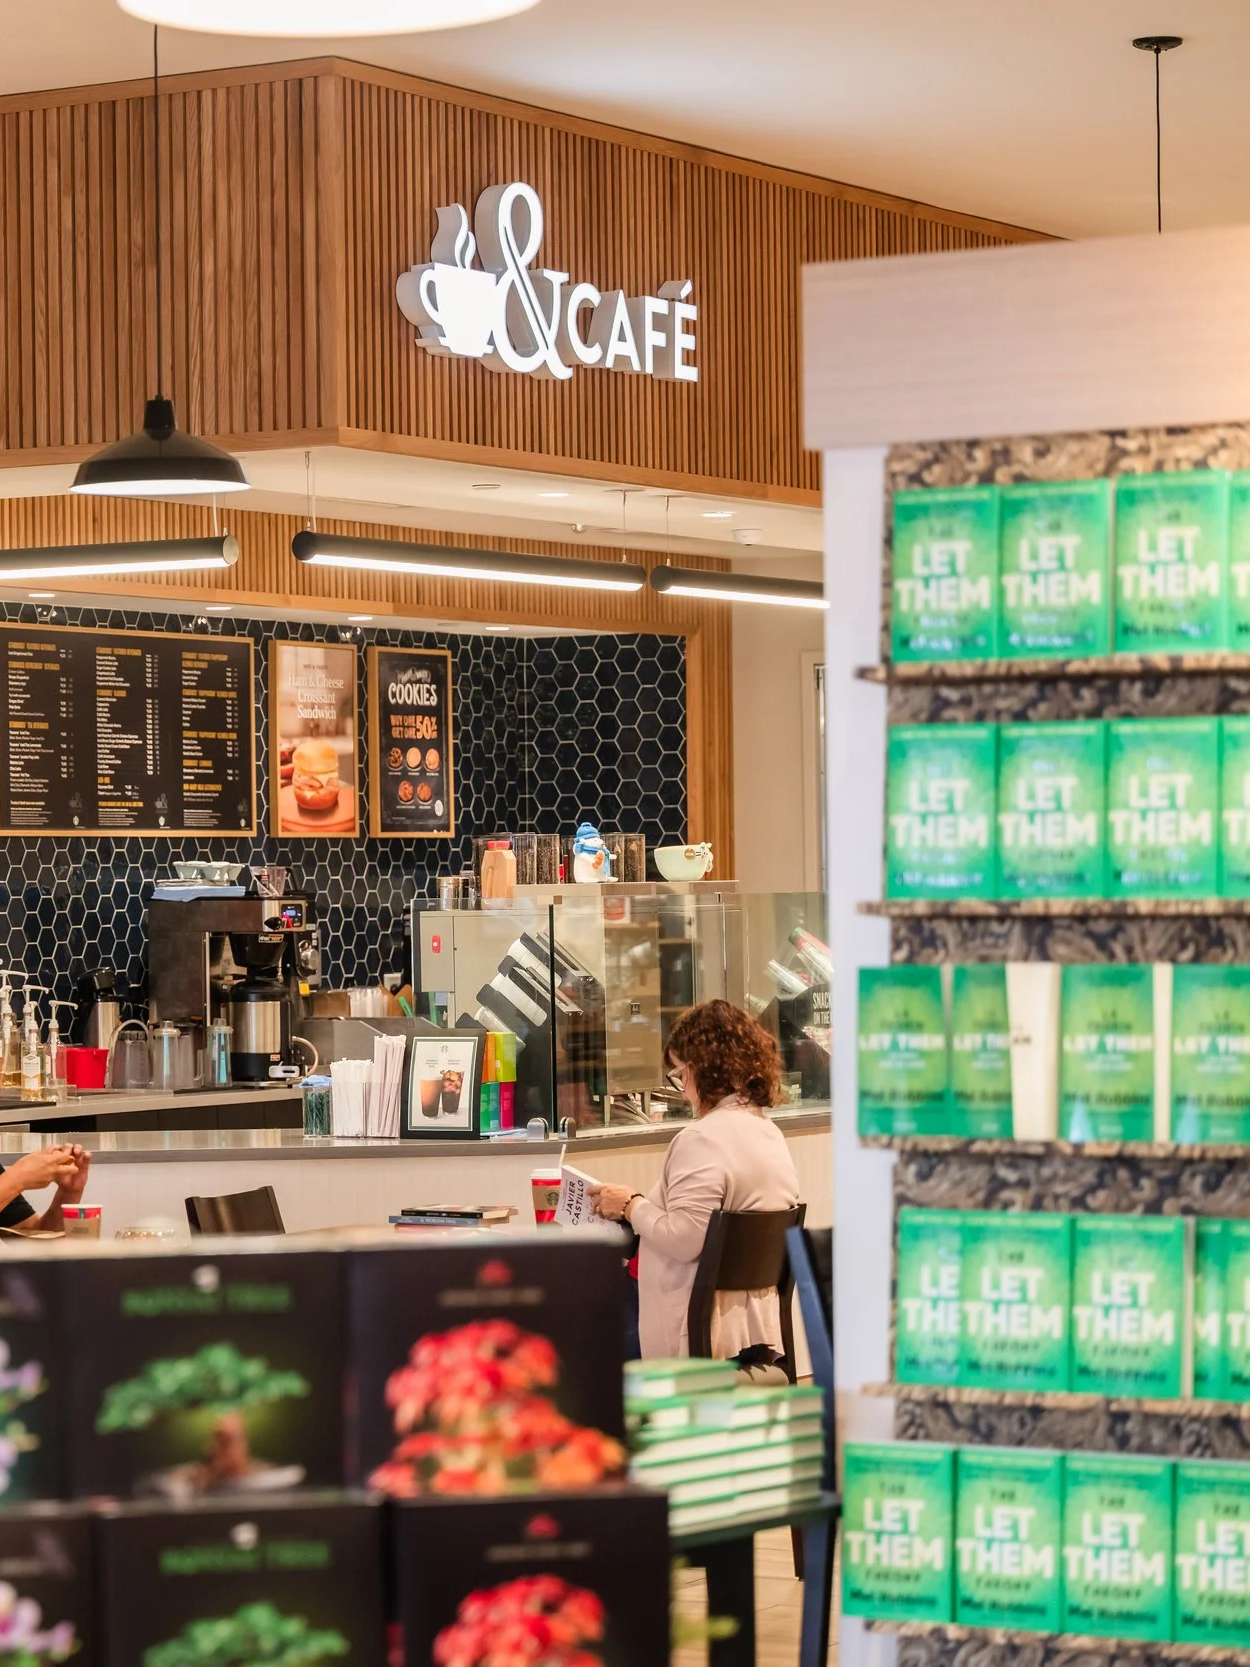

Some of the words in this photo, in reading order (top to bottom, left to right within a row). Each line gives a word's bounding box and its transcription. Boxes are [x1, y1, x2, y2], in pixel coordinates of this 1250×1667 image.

[567, 278, 699, 383] CAFÉ
[913, 540, 972, 575] LET
[1019, 536, 1082, 572] LET
[1138, 526, 1200, 562] LET
[895, 575, 991, 613] THEM
[1002, 569, 1101, 609] THEM
[1116, 561, 1219, 599] THEM
[298, 689, 336, 704] Croissant
[317, 673, 344, 689] Cheese
[388, 682, 438, 706] COOKIES
[297, 704, 337, 720] Sandwich
[909, 778, 971, 813] LET
[1016, 775, 1078, 811] LET
[1128, 773, 1193, 808] LET
[890, 811, 990, 850] THEM
[998, 811, 1097, 848] THEM
[1109, 808, 1212, 847] THEM
[859, 1033, 893, 1051] LET
[1062, 1034, 1100, 1053] LET
[1173, 1036, 1211, 1055] LET
[565, 1181, 576, 1216] JAVIER
[571, 1179, 585, 1226] CASTILLO
[920, 1264, 959, 1298] LE
[981, 1267, 1044, 1301] LET
[1091, 1269, 1155, 1306] LET
[902, 1298, 959, 1334] THE
[963, 1301, 1064, 1339] THEM
[1072, 1304, 1176, 1346] THEM
[863, 1497, 925, 1533] LET
[975, 1504, 1036, 1541] LET
[1081, 1511, 1147, 1548] LET
[845, 1530, 945, 1572] THEM
[956, 1537, 1056, 1580] THEM
[1062, 1544, 1166, 1588] THEM
